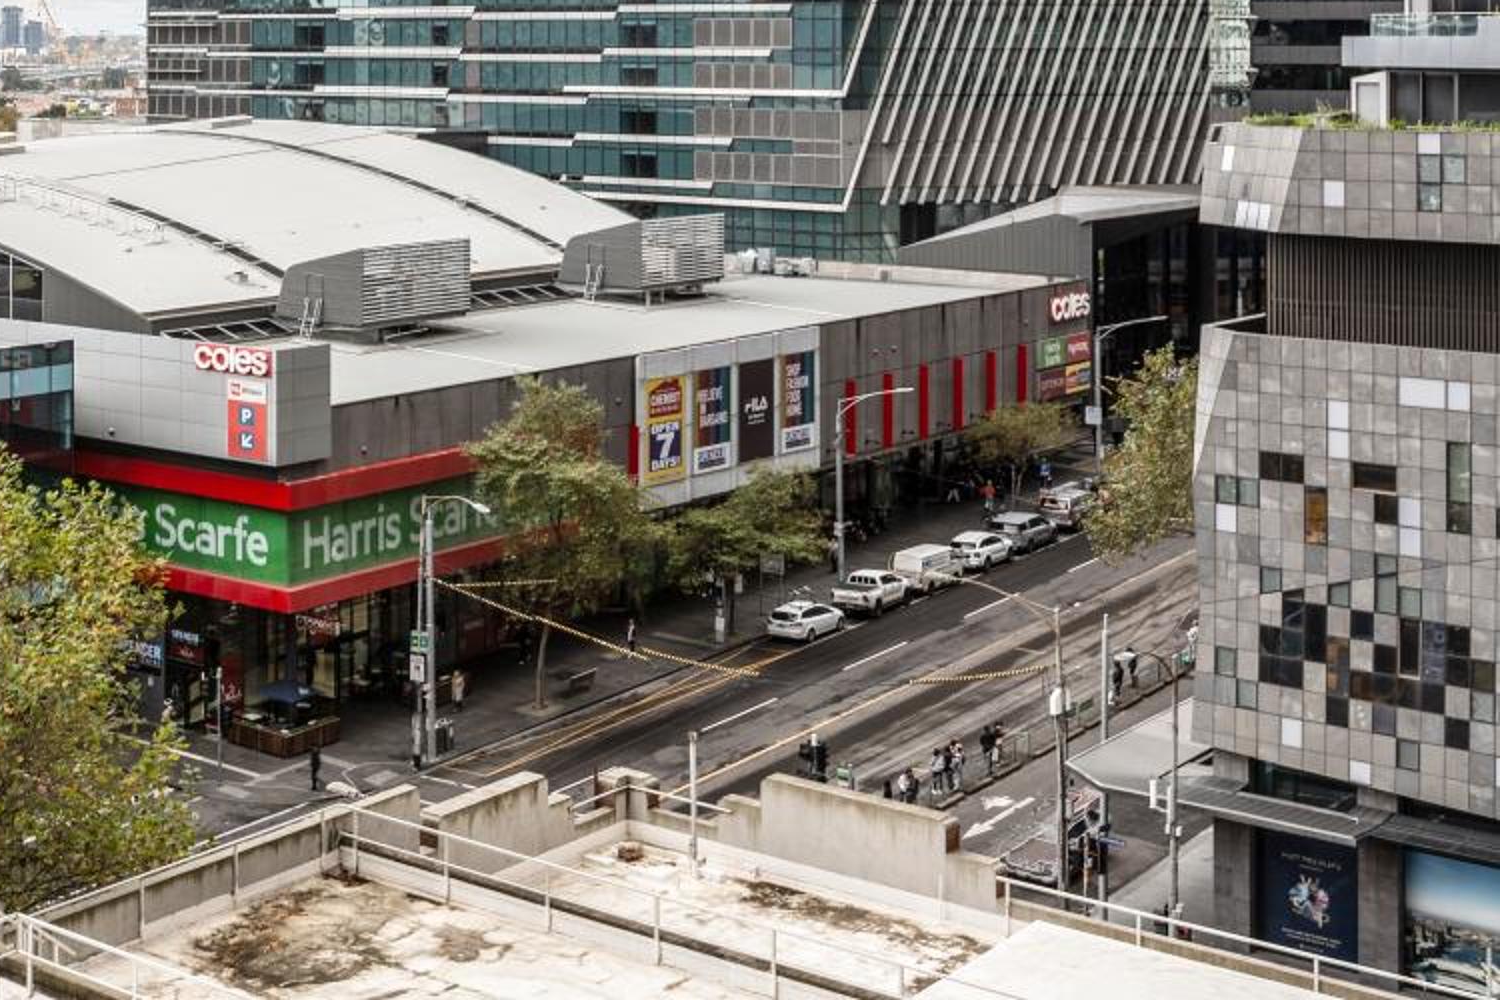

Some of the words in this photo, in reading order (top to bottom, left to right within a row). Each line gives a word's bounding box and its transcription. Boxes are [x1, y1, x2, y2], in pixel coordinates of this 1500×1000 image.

[1051, 292, 1091, 322] coles
[194, 345, 268, 377] coles
[241, 407, 252, 424] P
[744, 395, 768, 414] FILA
[651, 422, 679, 435] OPEN
[656, 432, 675, 459] 7
[154, 503, 269, 567] Scarfe
[303, 503, 401, 569] Harris
